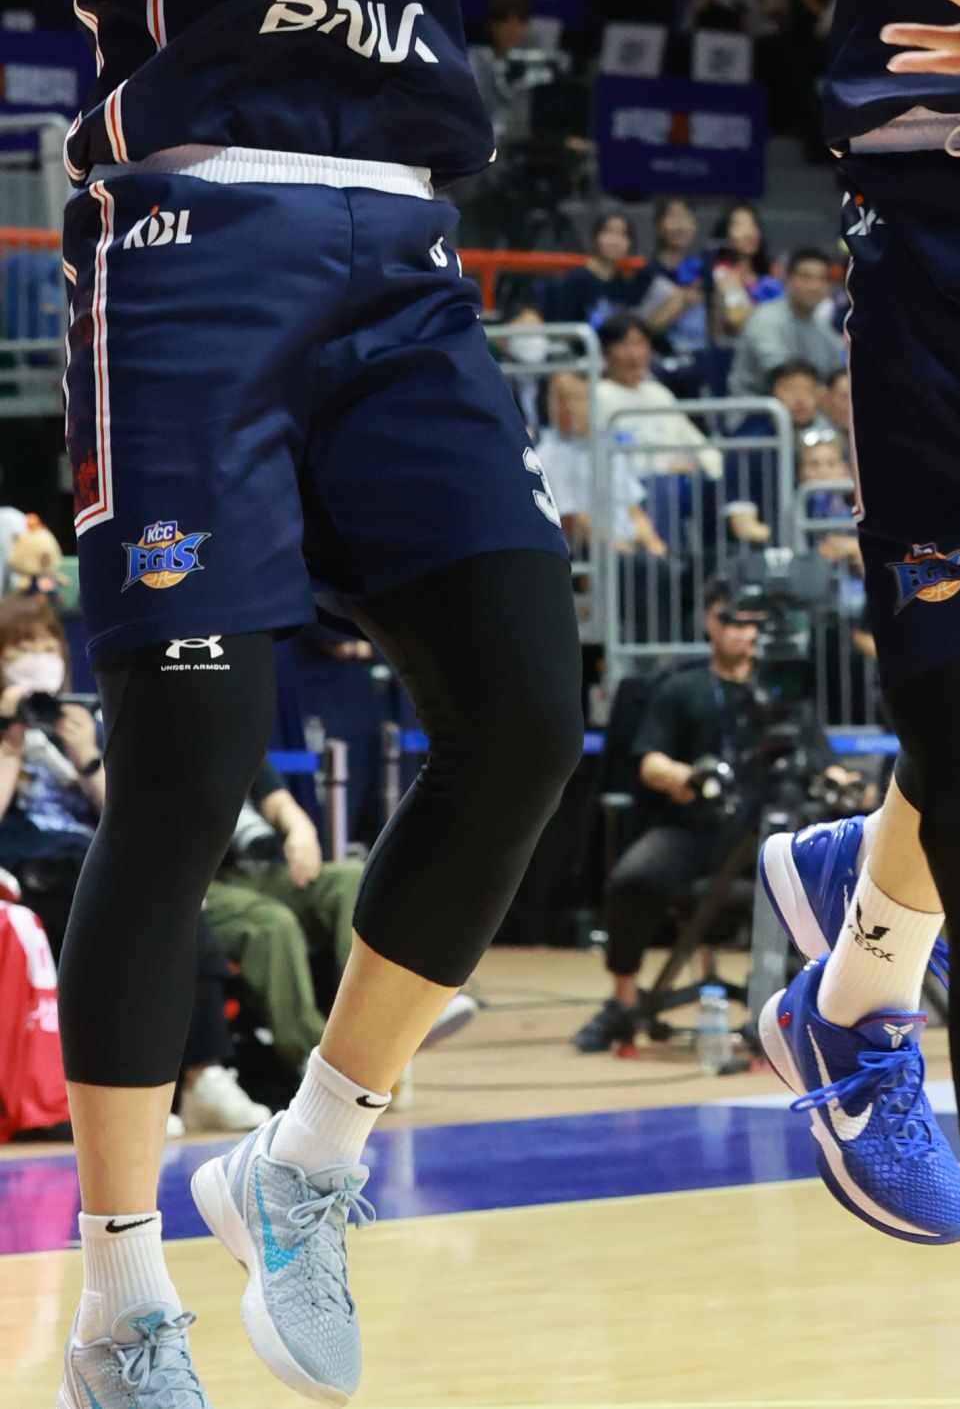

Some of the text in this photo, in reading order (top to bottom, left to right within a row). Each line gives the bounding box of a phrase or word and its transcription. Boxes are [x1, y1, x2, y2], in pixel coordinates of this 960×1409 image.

[123, 205, 192, 250] KBL
[146, 523, 173, 543] KCC
[123, 533, 211, 588] EGIS
[161, 664, 191, 672] UNDER
